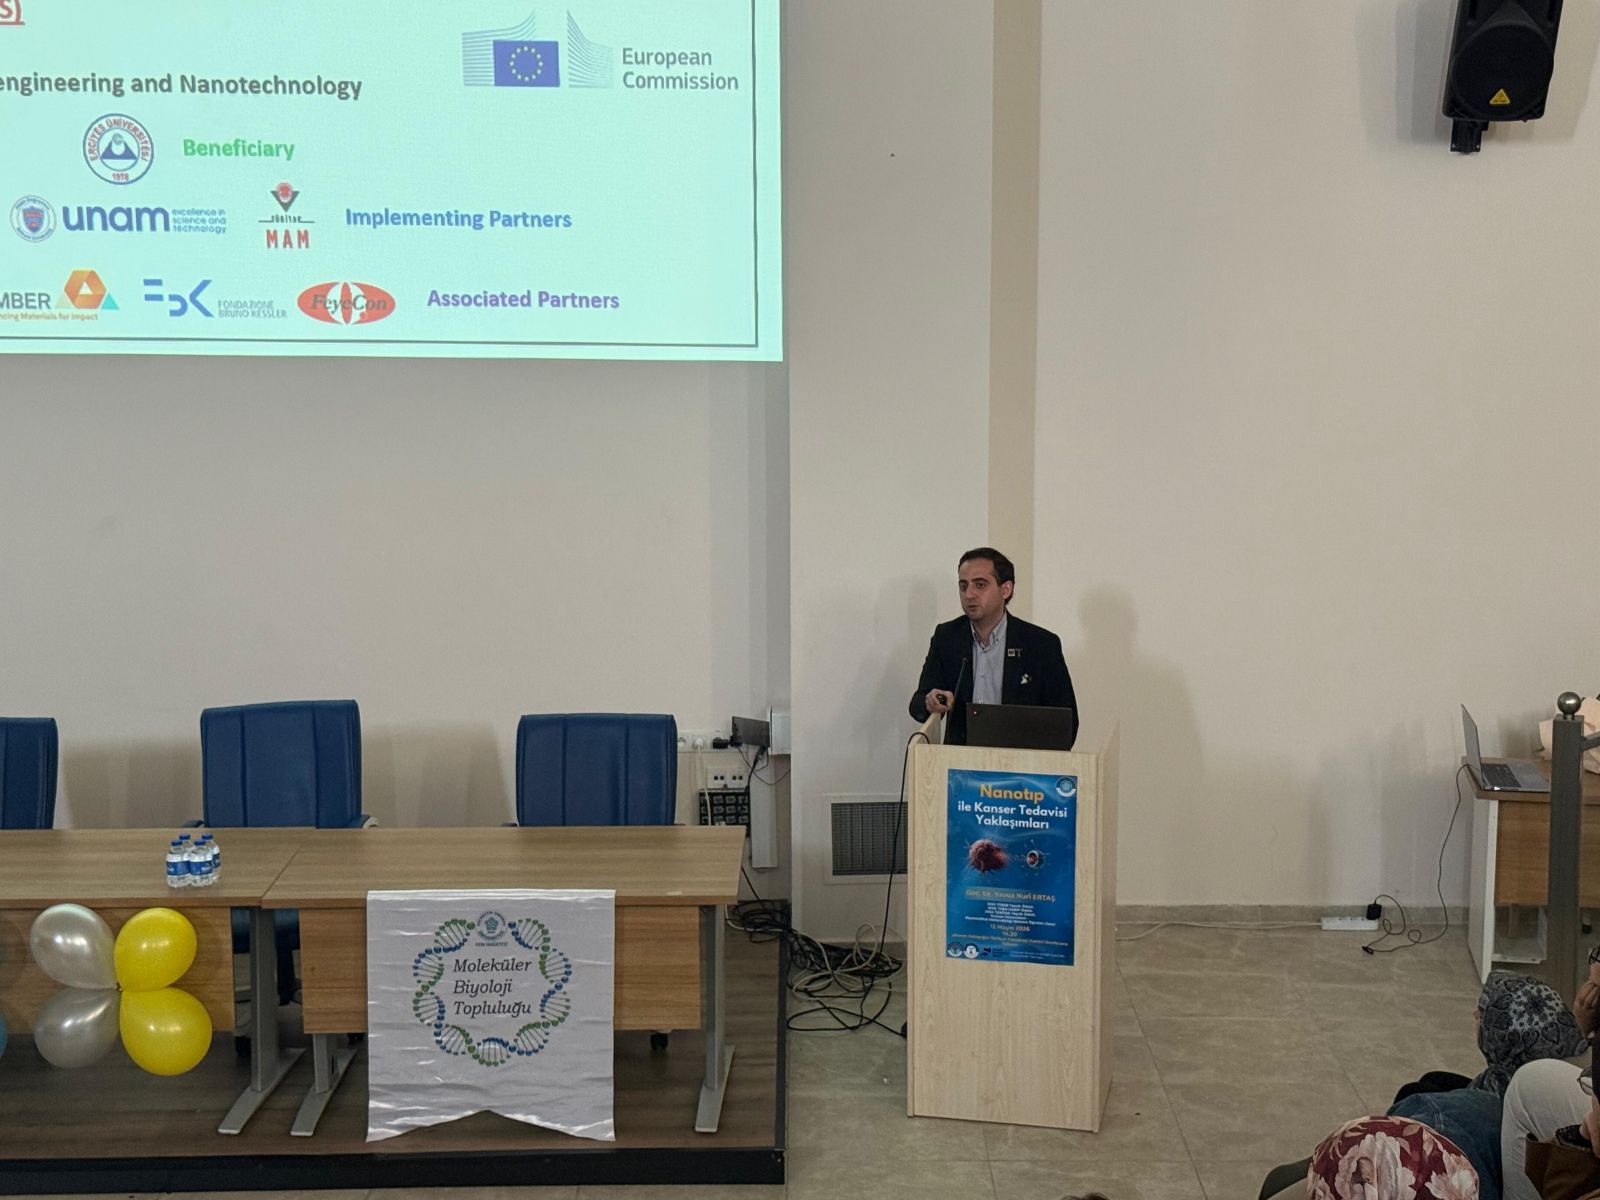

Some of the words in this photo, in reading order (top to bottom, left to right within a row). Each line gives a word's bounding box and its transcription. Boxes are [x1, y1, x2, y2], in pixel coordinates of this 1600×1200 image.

[622, 47, 712, 69] European
[131, 74, 172, 93] and
[180, 74, 362, 100] Nanotechnology
[622, 71, 739, 90] Commission
[183, 139, 295, 161] Beneficiary
[62, 206, 170, 232] unam
[172, 208, 217, 216] excellence
[219, 208, 226, 216] in
[172, 217, 206, 225] science
[209, 217, 226, 225] and
[346, 208, 484, 230] Implementing
[489, 210, 572, 228] Partners
[173, 224, 226, 234] technology
[266, 229, 310, 249] MAM
[218, 300, 274, 309] FONDAZIONE
[311, 294, 387, 314] FeyeCon
[427, 290, 531, 308] Associated
[538, 291, 620, 309] Partners
[20, 312, 57, 320] Materials
[58, 312, 70, 320] for
[71, 312, 98, 321] Impact
[218, 310, 249, 318] BRUNO
[251, 310, 288, 318] KESSLER
[980, 783, 1045, 804] Nanotıp
[958, 801, 972, 812] ile
[974, 802, 1016, 814] Kanser
[1019, 804, 1068, 818] Tedavisi
[976, 814, 1049, 829] Yaklaşımları
[453, 958, 532, 973] Moleküler
[453, 978, 513, 997] Biyoloji
[453, 1000, 532, 1018] Topluluğu
